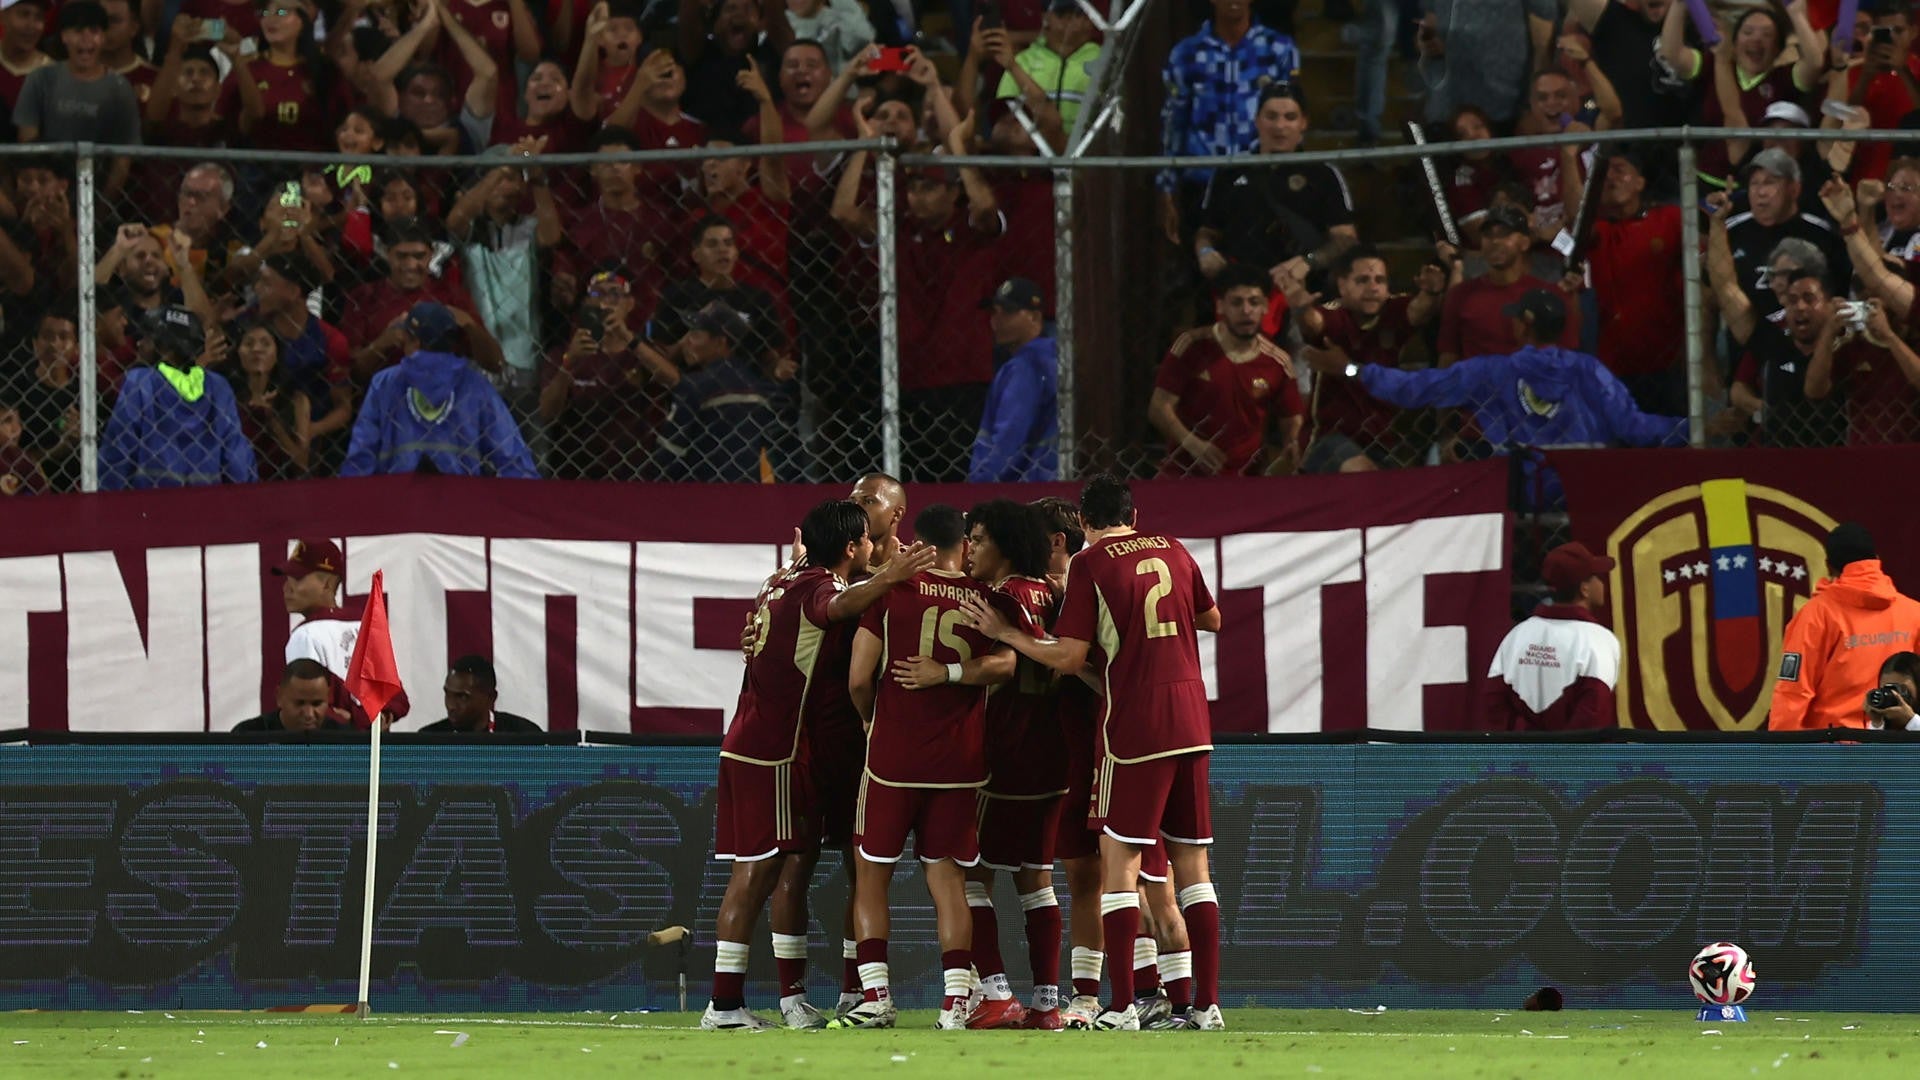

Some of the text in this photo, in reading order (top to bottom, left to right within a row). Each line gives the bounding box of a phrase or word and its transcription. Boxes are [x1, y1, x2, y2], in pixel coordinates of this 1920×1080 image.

[277, 101, 300, 125] 10
[1105, 535, 1171, 559] FERRARESI
[1135, 558, 1178, 639] 2
[918, 605, 976, 663] 15
[1844, 631, 1911, 649] SECURITY
